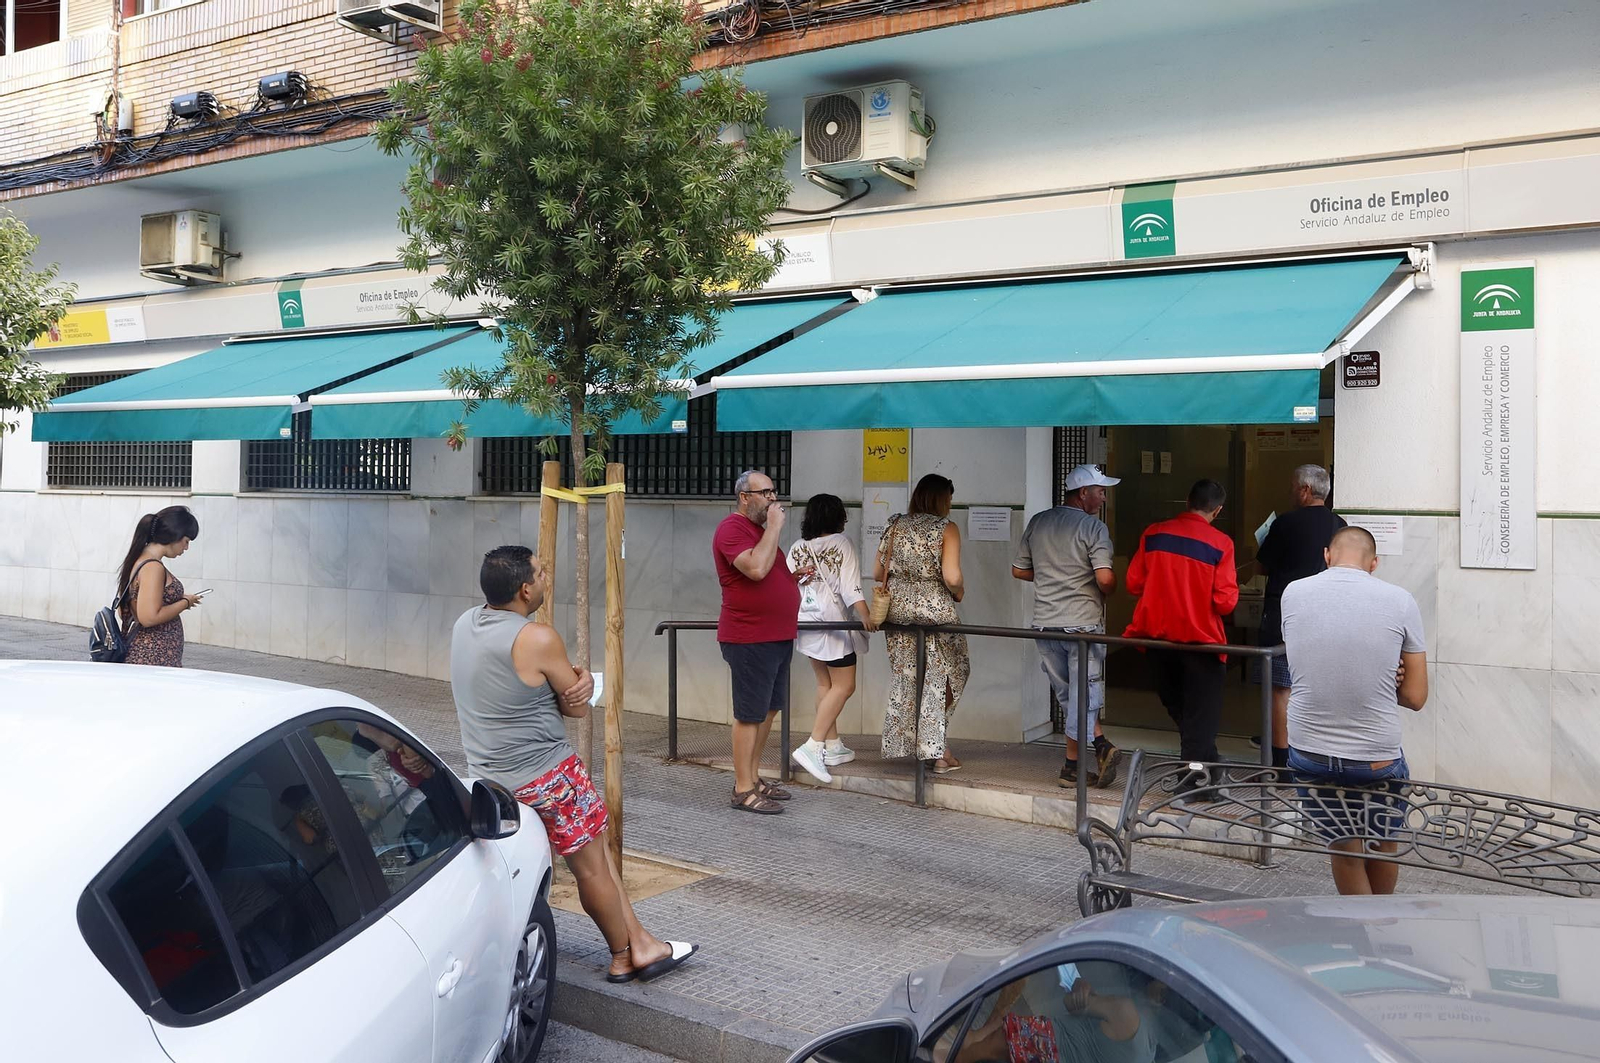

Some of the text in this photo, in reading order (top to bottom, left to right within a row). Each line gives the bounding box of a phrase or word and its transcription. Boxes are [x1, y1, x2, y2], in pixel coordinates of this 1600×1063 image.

[1300, 207, 1450, 230] Servicio Andaluz de Empleo
[1310, 188, 1449, 214] Oficina de Empleo
[360, 288, 419, 303] Oficina de Empleo
[1500, 344, 1510, 393] COMERCIO
[1482, 345, 1496, 476] Servicio Andaluz de Empleo
[1500, 402, 1510, 443] EMPRESA
[1500, 444, 1511, 483] EMPLEO,
[1500, 485, 1510, 497] DE
[1498, 499, 1510, 554] CONSEJERÍA
